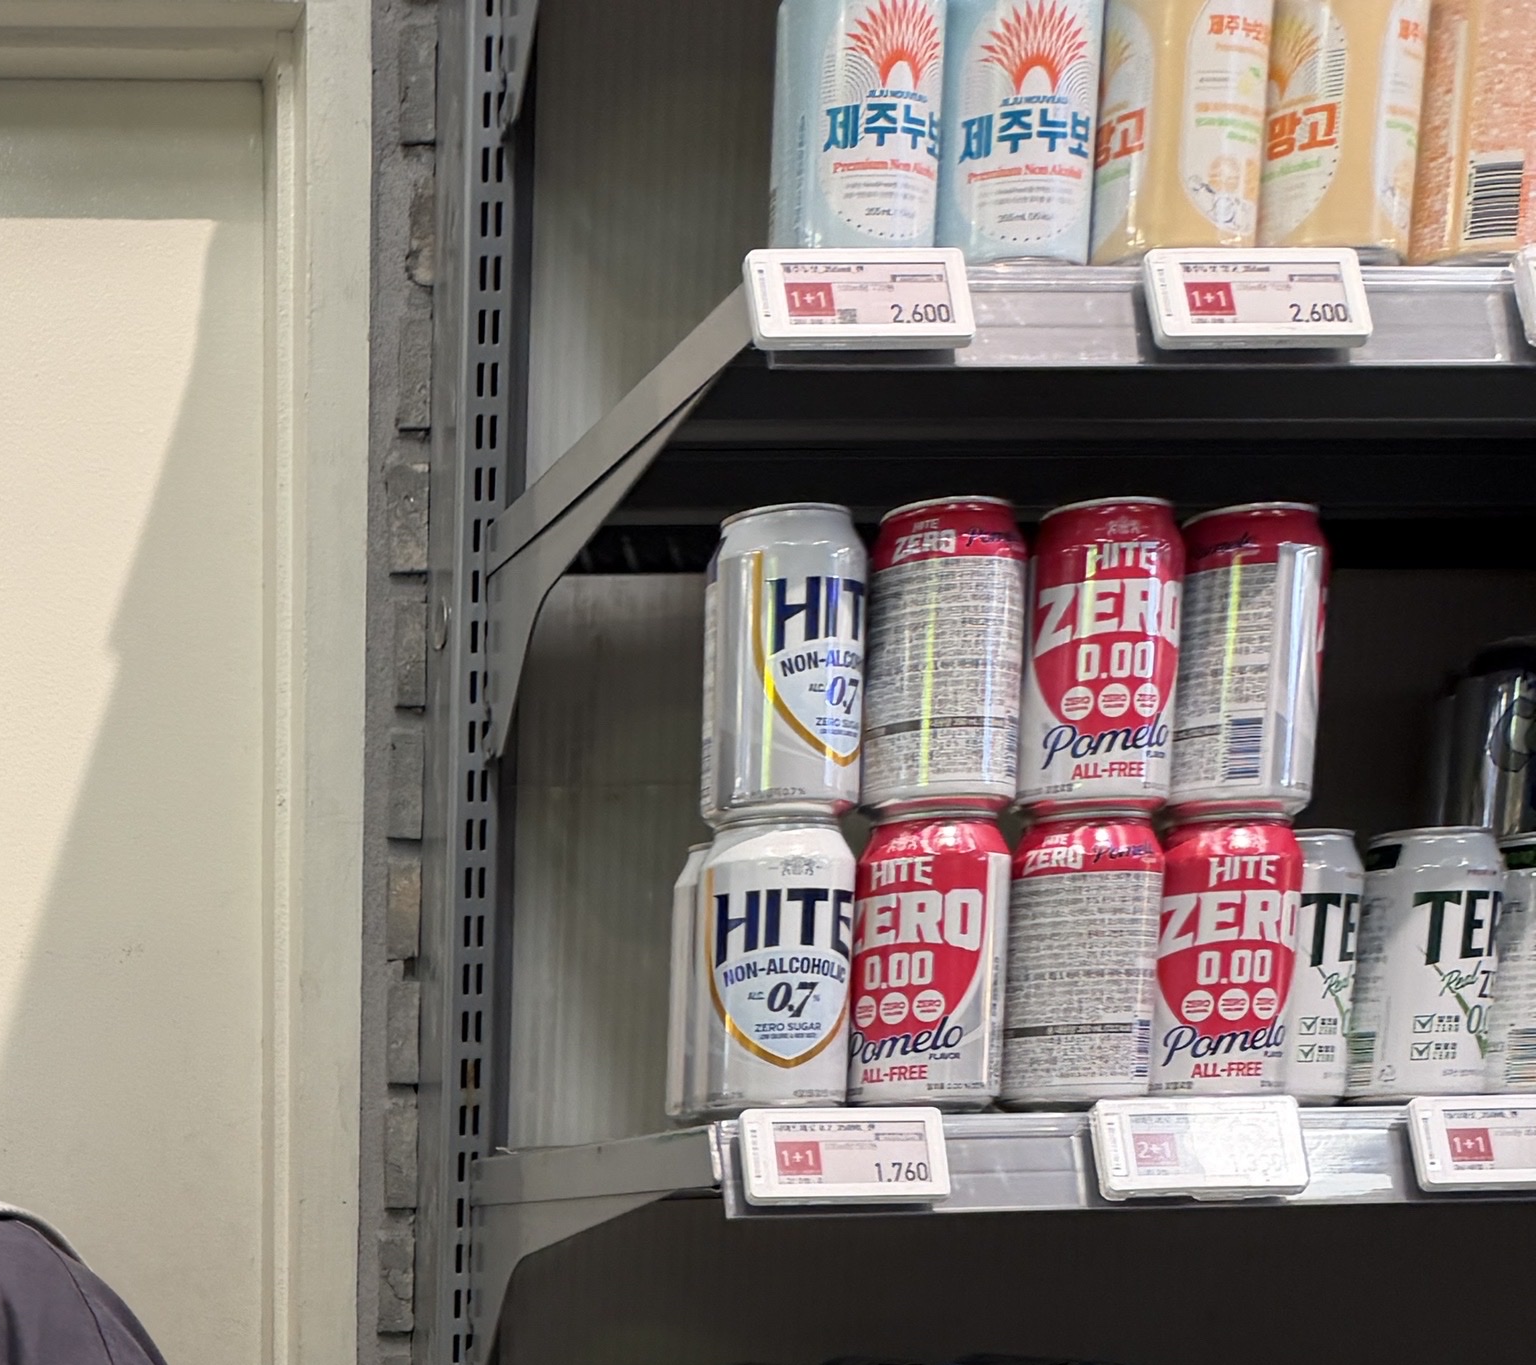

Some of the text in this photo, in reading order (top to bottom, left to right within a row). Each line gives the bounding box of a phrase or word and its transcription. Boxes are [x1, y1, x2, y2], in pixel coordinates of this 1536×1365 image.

[958, 108, 1092, 164] 제주누보
[1268, 102, 1337, 161] 망고
[968, 170, 1021, 184] Premium
[1025, 166, 1048, 177] Non
[791, 291, 826, 308] 1+1
[1191, 289, 1228, 307] 1+1
[892, 529, 956, 563] ZERO
[1086, 541, 1161, 577] HITE
[1034, 578, 1183, 658] ZERO
[1076, 640, 1155, 682] 0.00
[1072, 762, 1145, 780] ALL-FREE
[870, 856, 935, 890] HITE
[1023, 844, 1084, 876] ZERO
[1209, 854, 1280, 888] HITE
[713, 888, 854, 969] HITE
[1156, 890, 1302, 960] ZERO
[723, 956, 846, 988] NON-ALCOHOLIC
[864, 951, 934, 989] 0.00
[1197, 949, 1272, 986] 0.00
[754, 1022, 821, 1032] ZERO SUGAR
[849, 1016, 963, 1070] Pomelo
[1162, 1012, 1285, 1066] Pomelo
[862, 1064, 928, 1083] ALL-FREE
[1191, 1062, 1263, 1078] ALL-FREE
[782, 1150, 814, 1166] 1+1
[1453, 1136, 1485, 1153] 1+1
